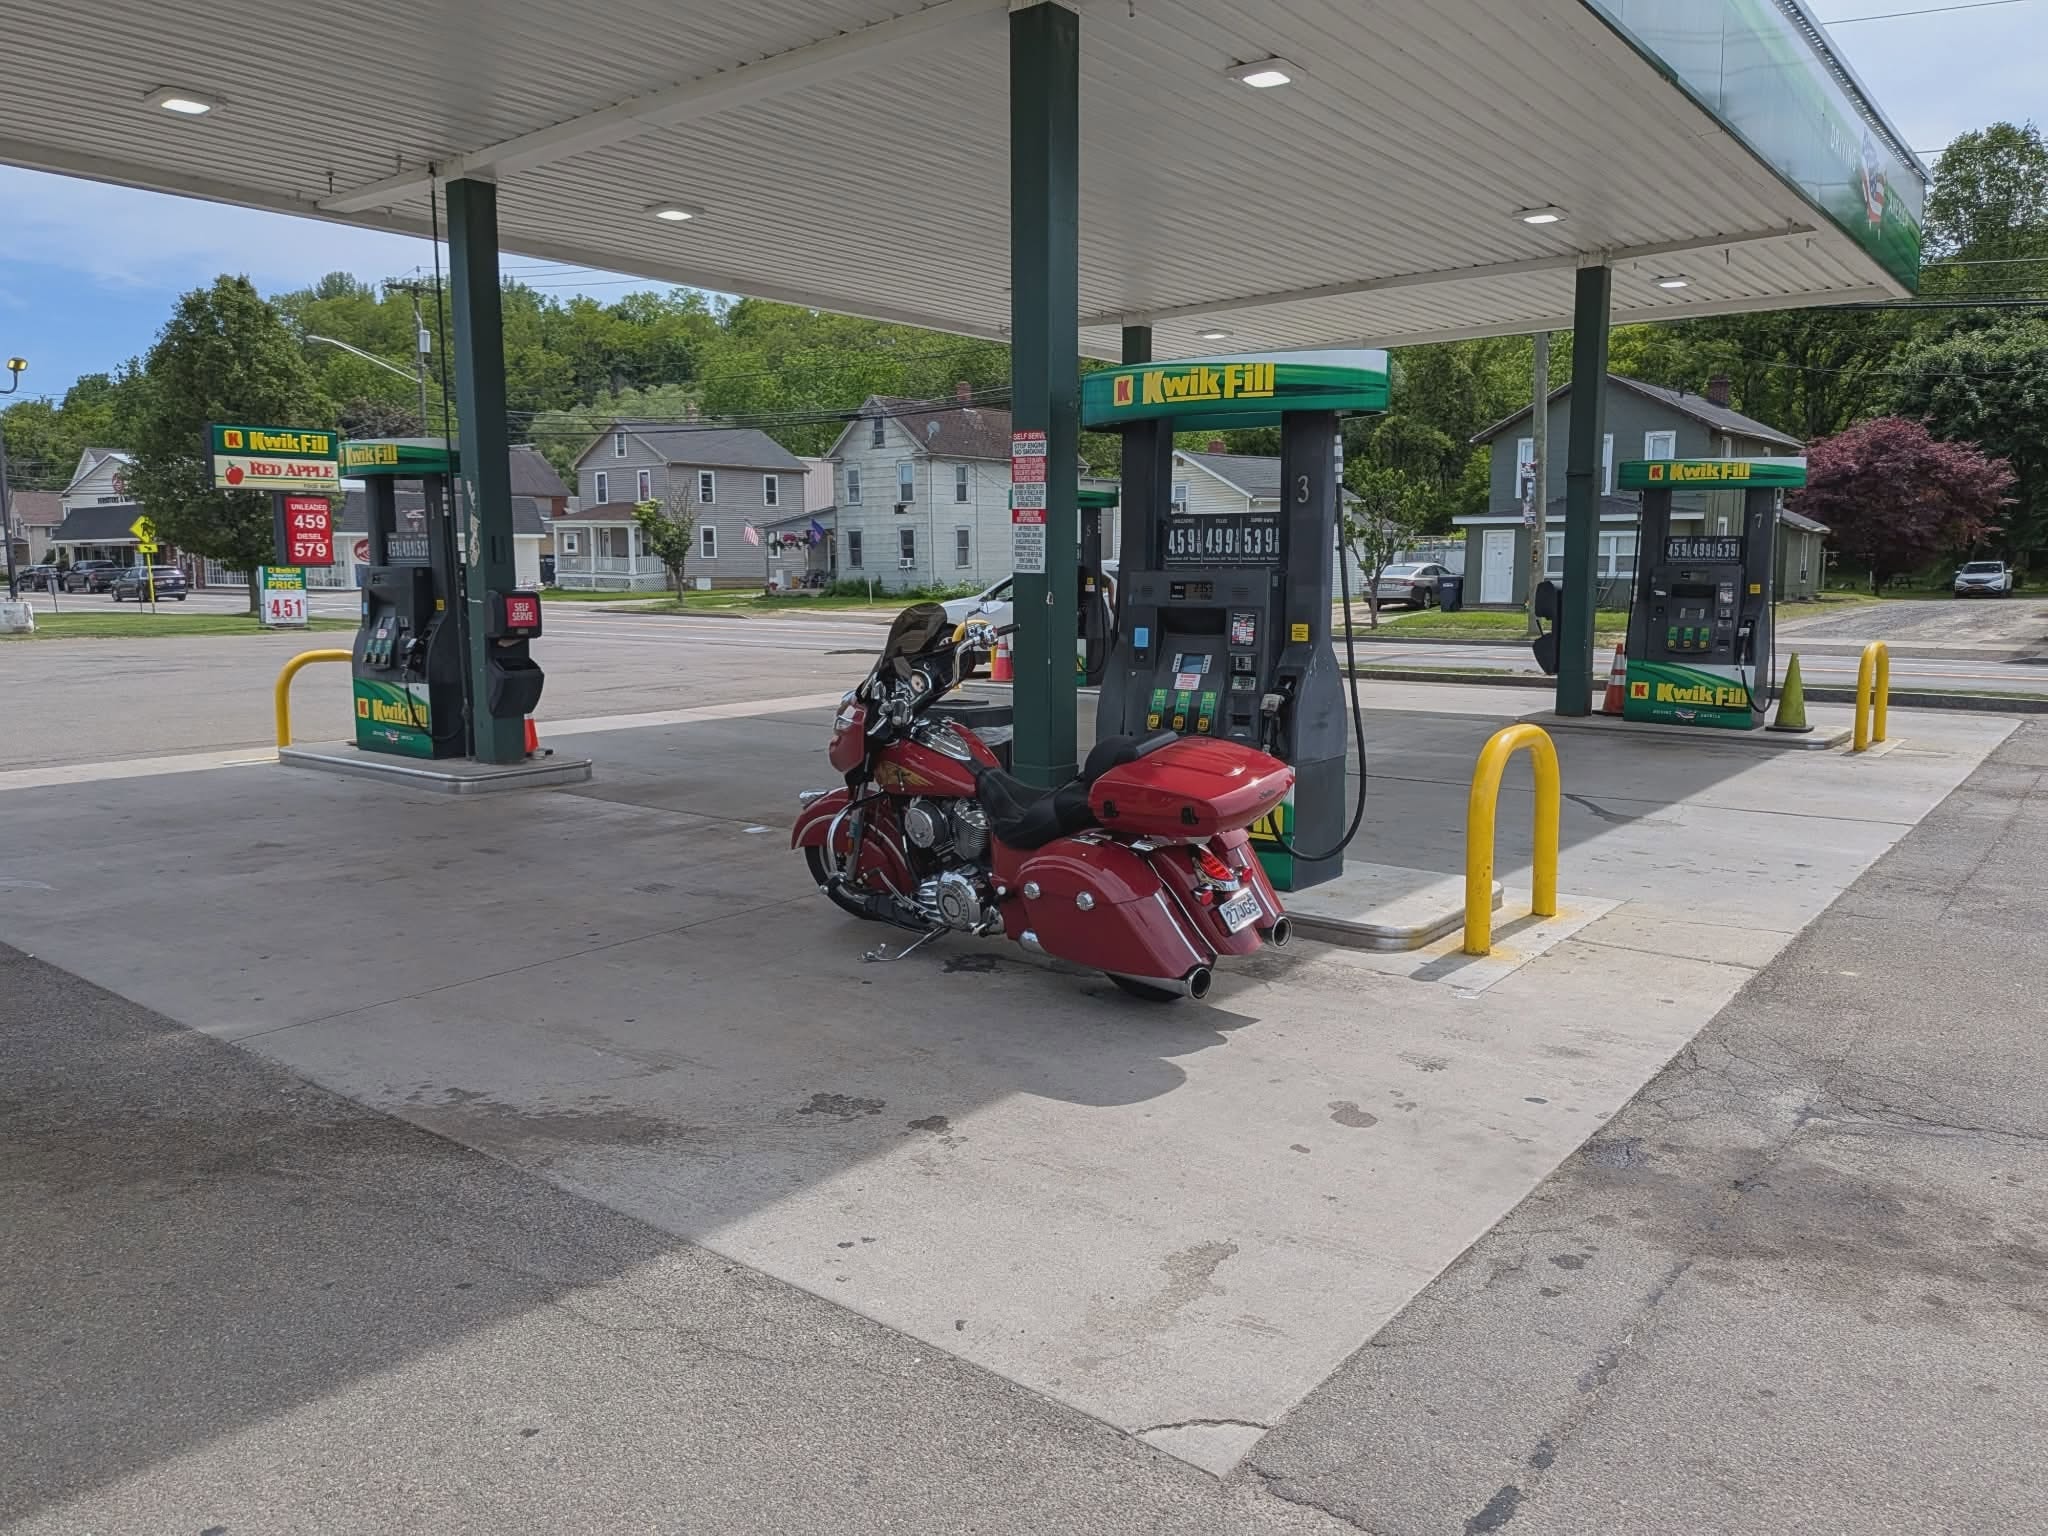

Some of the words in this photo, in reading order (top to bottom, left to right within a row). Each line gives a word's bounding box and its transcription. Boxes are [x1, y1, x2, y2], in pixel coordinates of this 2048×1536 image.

[1142, 367, 1221, 404] Kwik
[1224, 362, 1275, 398] Fill
[249, 431, 301, 452] Kwik
[301, 434, 329, 454] Fill
[376, 444, 398, 465] Fill
[249, 461, 281, 476] RED
[284, 463, 334, 478] APPLE
[1670, 463, 1719, 480] Kwik
[1721, 463, 1750, 479] Fill
[1297, 475, 1309, 503] 3
[290, 503, 327, 511] UNLEADED
[294, 514, 327, 529] 459
[1755, 513, 1762, 529] 7
[296, 532, 322, 540] DIESEL
[294, 543, 327, 557] 579
[268, 581, 303, 589] PRICE
[514, 602, 529, 612] SELF
[511, 611, 534, 621] SERVE
[1657, 683, 1713, 704] Kwik
[1715, 686, 1748, 708] Fill
[373, 698, 408, 725] Kwik
[1225, 899, 1257, 925] 27JG5
